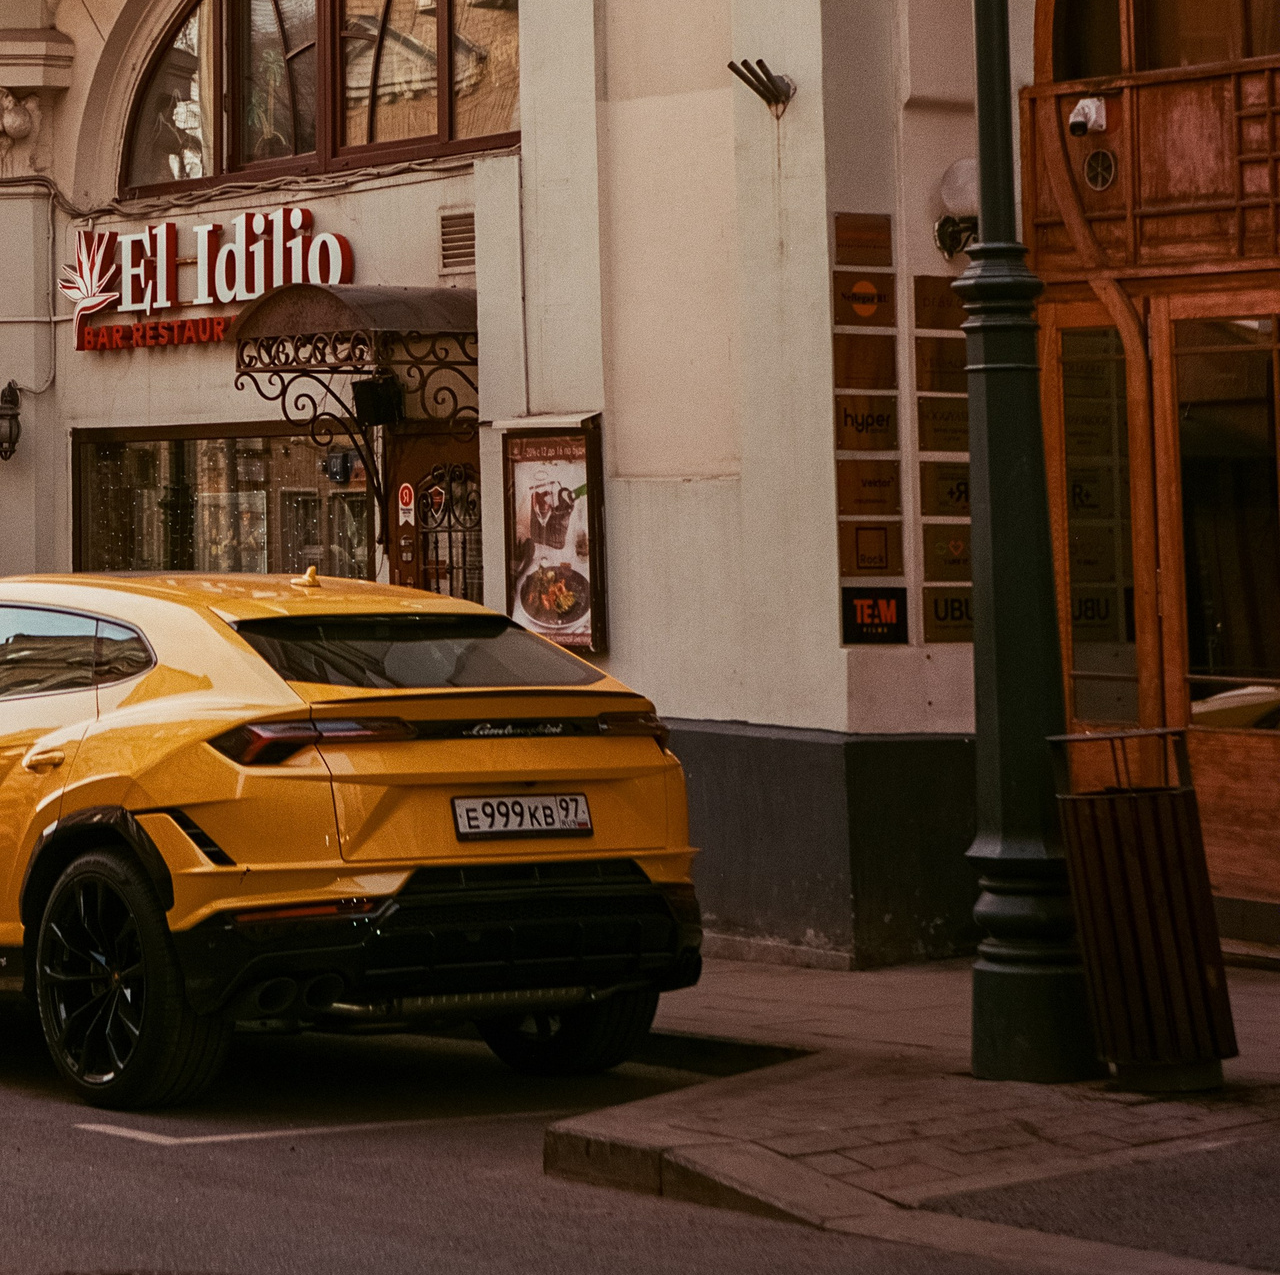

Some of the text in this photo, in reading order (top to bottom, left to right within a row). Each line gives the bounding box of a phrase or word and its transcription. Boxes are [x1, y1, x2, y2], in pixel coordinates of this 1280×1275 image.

[117, 207, 344, 316] El Idilio
[84, 315, 236, 350] BAR RESTAUR
[843, 407, 891, 433] hyper
[853, 599, 897, 624] TEAM
[559, 798, 579, 819] 97
